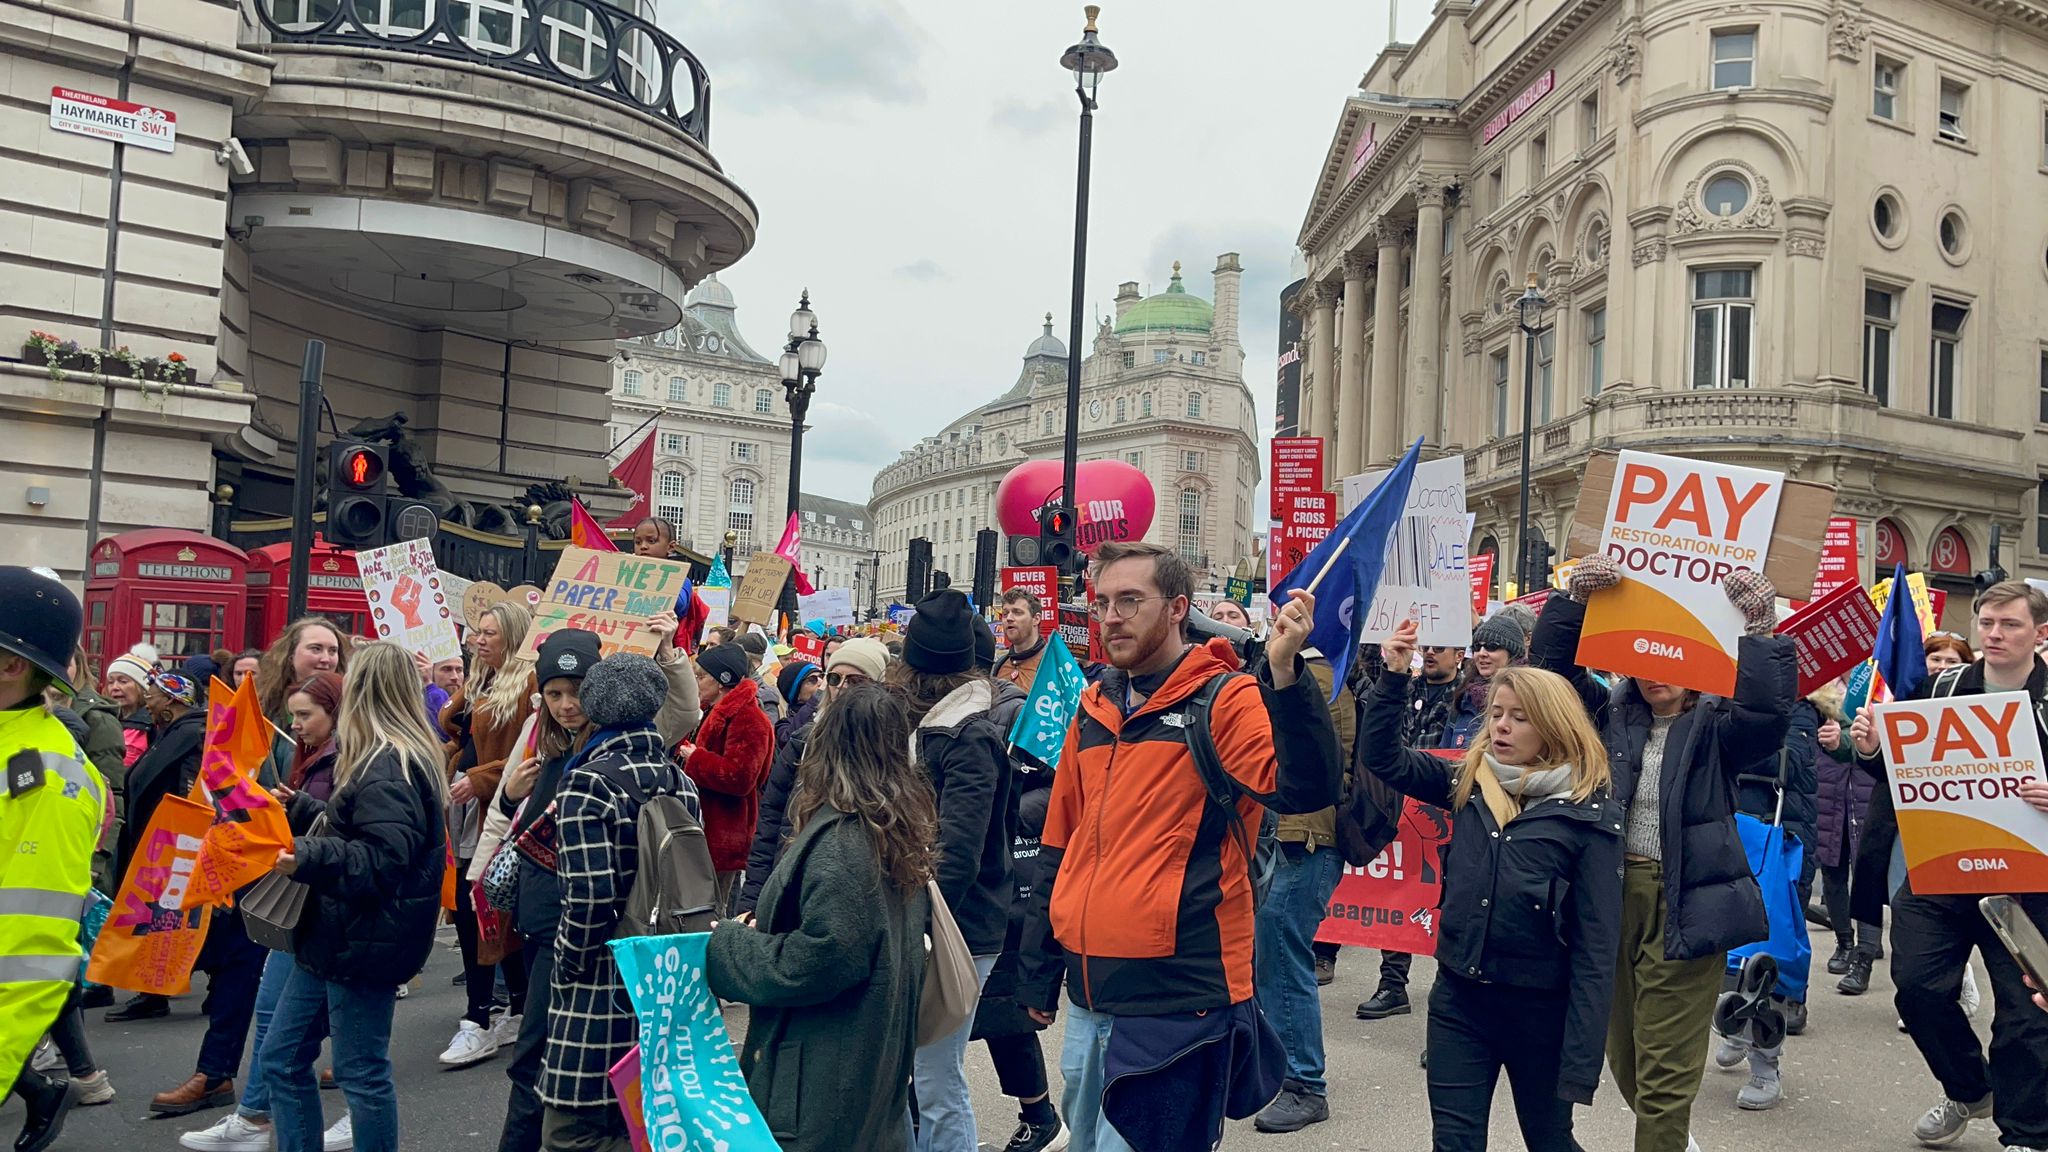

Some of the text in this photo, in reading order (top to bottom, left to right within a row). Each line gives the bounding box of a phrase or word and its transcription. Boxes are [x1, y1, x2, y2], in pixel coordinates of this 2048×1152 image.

[61, 90, 108, 106] THEATRELAND
[1484, 71, 1551, 145] BODY WORLDS
[60, 104, 168, 136] HAYMARKET SW1
[58, 120, 71, 128] CITY
[83, 124, 124, 139] WESTMINSTER
[1294, 497, 1325, 509] NEVER
[1408, 475, 1464, 514] DOCTORS
[1614, 462, 1771, 542] PAY
[1088, 500, 1125, 522] OUR
[1293, 512, 1326, 524] CROSS
[1286, 526, 1330, 538] A PICKET
[1430, 525, 1464, 570] SALE
[1610, 526, 1757, 562] RESTORATION FOR
[144, 564, 229, 580] TELEPHONE
[574, 554, 680, 592] A WET
[752, 576, 766, 584] AND
[1013, 572, 1046, 582] NEVER
[309, 574, 364, 590] LEPHON
[1232, 580, 1247, 588] FAIR
[742, 584, 776, 600] PAY UP!
[566, 612, 642, 640] CAN'T
[1060, 634, 1090, 646] ELCOME
[1649, 641, 1684, 660] BMA
[1883, 702, 2020, 764] PAY
[18, 770, 32, 781] SW
[1896, 760, 2036, 780] RESTORATION FOR
[1974, 858, 2008, 870] BMA
